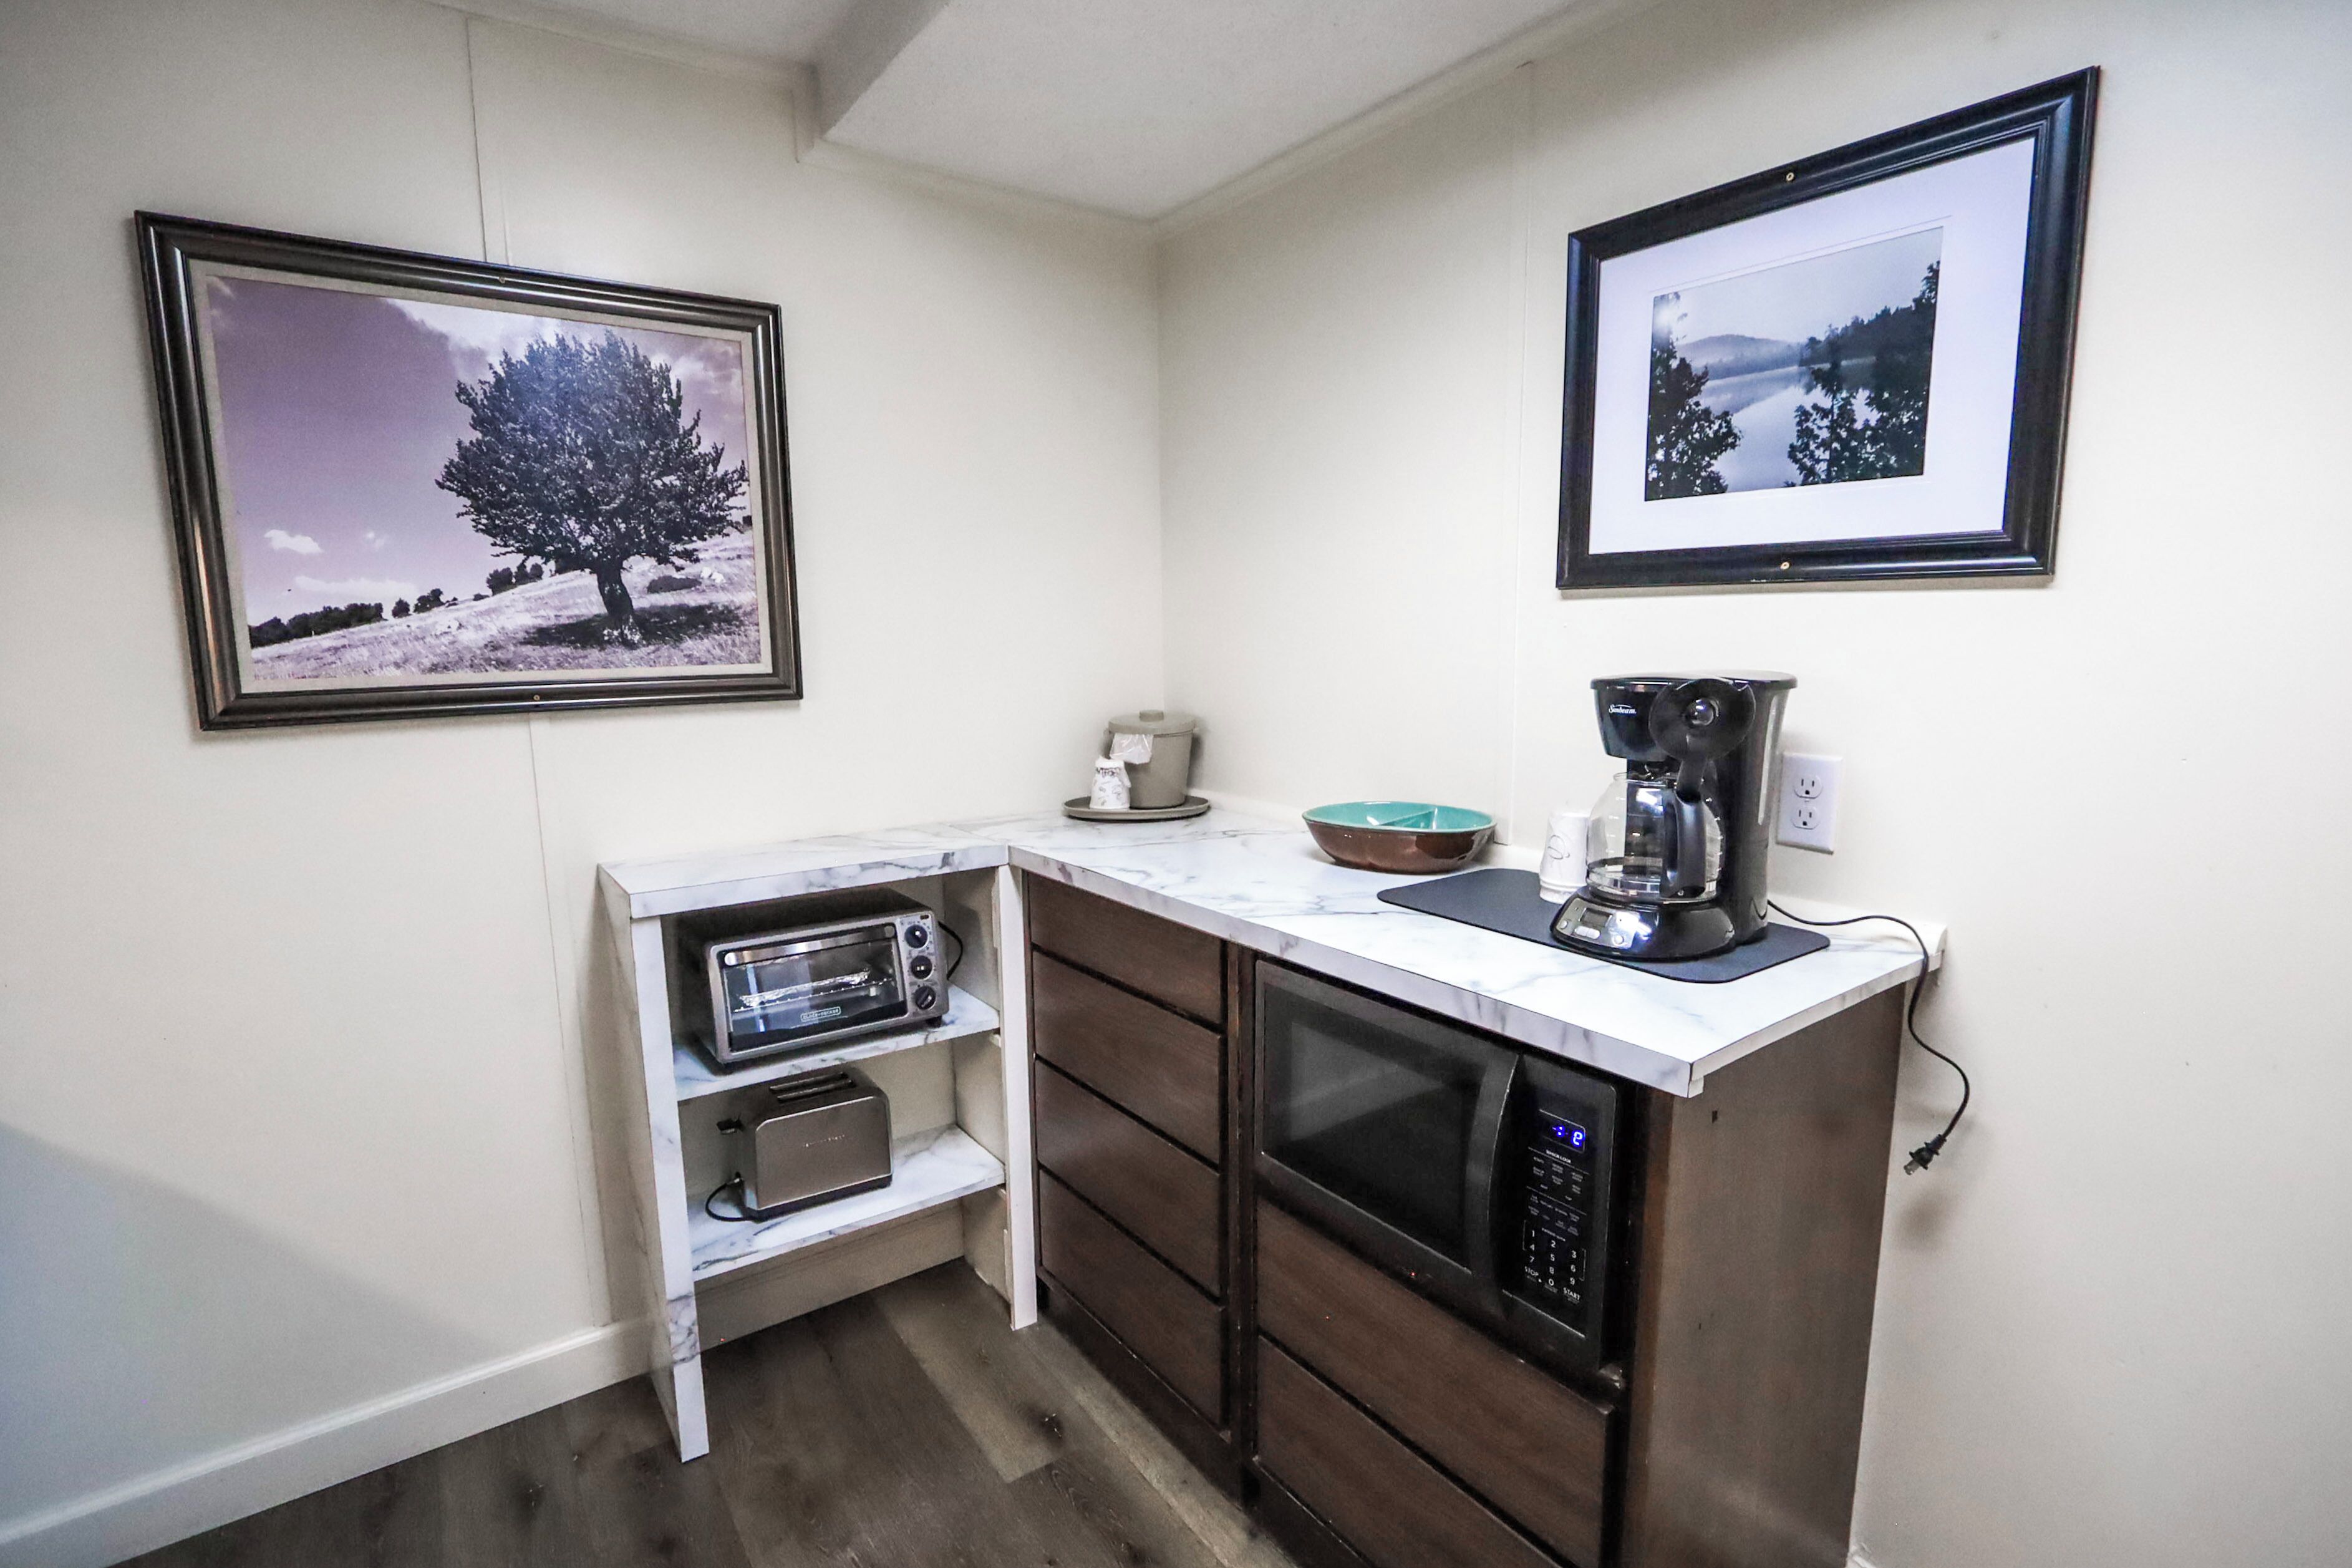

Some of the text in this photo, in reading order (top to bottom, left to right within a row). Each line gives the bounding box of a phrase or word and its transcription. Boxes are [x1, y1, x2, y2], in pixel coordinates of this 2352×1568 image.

[1608, 704, 1637, 714] Sunbeam
[1551, 1239, 1556, 1248] 2
[1529, 1255, 1535, 1263] 7
[1550, 1253, 1555, 1262] 5
[1571, 1250, 1577, 1259] 3
[1524, 1266, 1539, 1277] STOP
[1549, 1266, 1554, 1275] 8
[1570, 1264, 1576, 1273] 6
[1548, 1278, 1554, 1286] 0
[1569, 1277, 1575, 1285] 9
[1562, 1287, 1581, 1301] START
